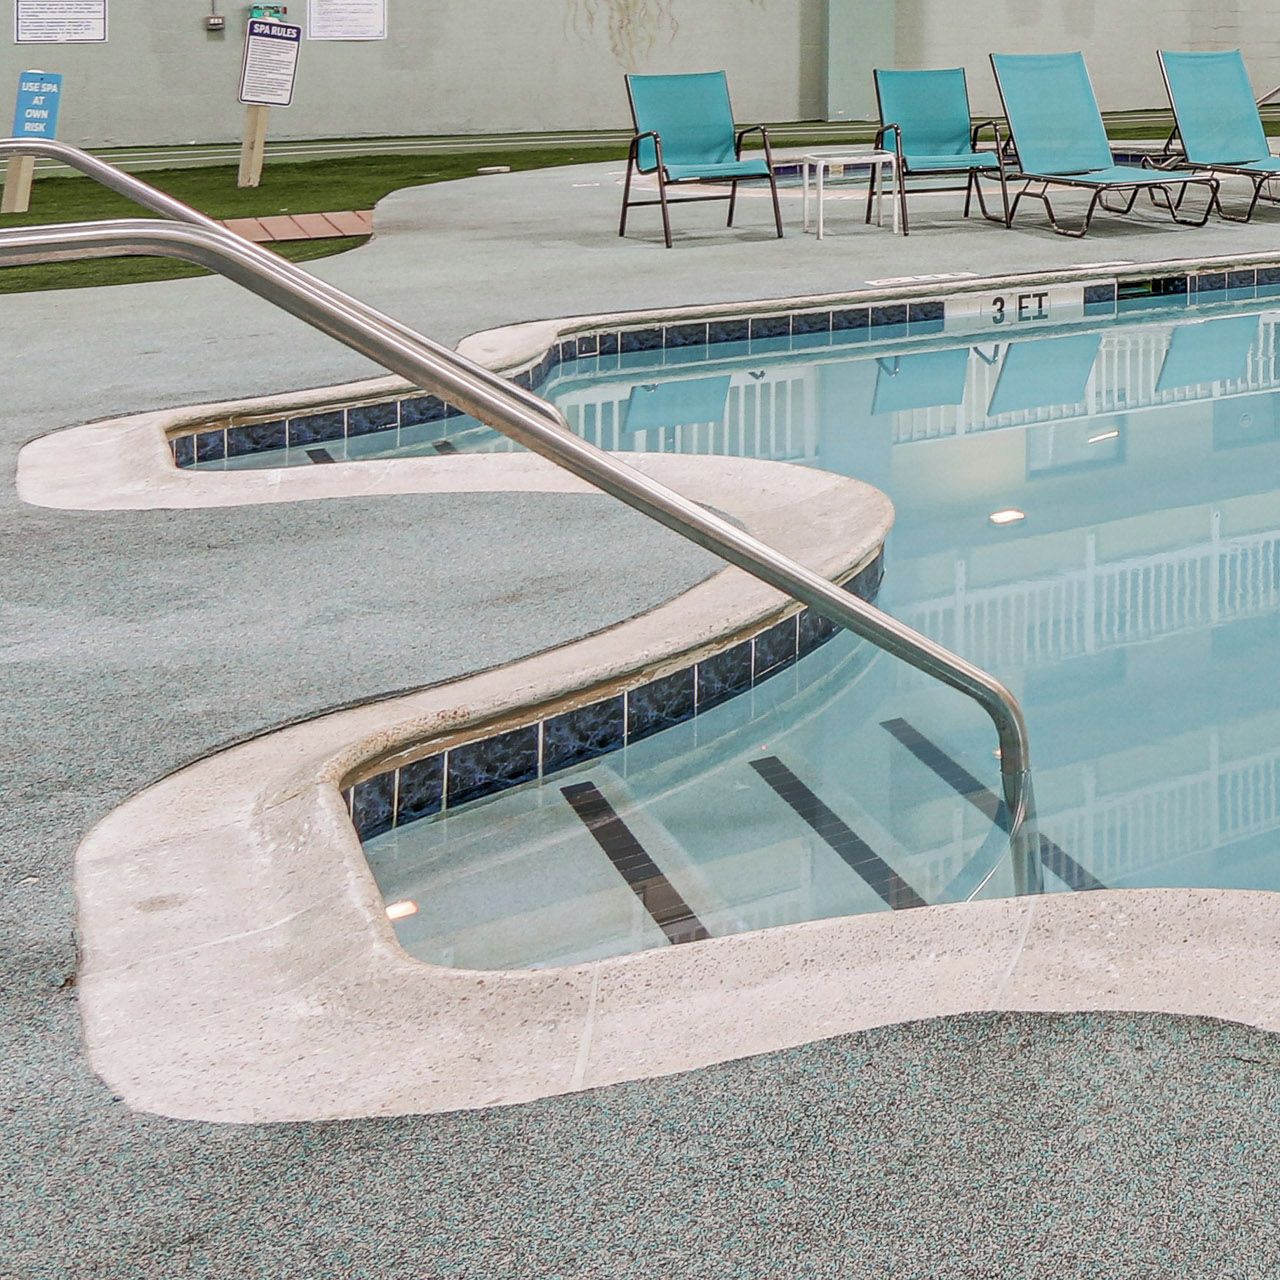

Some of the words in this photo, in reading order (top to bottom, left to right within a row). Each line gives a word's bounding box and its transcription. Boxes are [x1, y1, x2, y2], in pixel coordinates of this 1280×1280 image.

[253, 23, 270, 34] SPA
[270, 26, 297, 37] RULES
[22, 82, 40, 92] USE
[41, 83, 58, 93] SPA
[32, 96, 45, 105] AT
[25, 109, 48, 119] OWN
[24, 122, 46, 132] RISK
